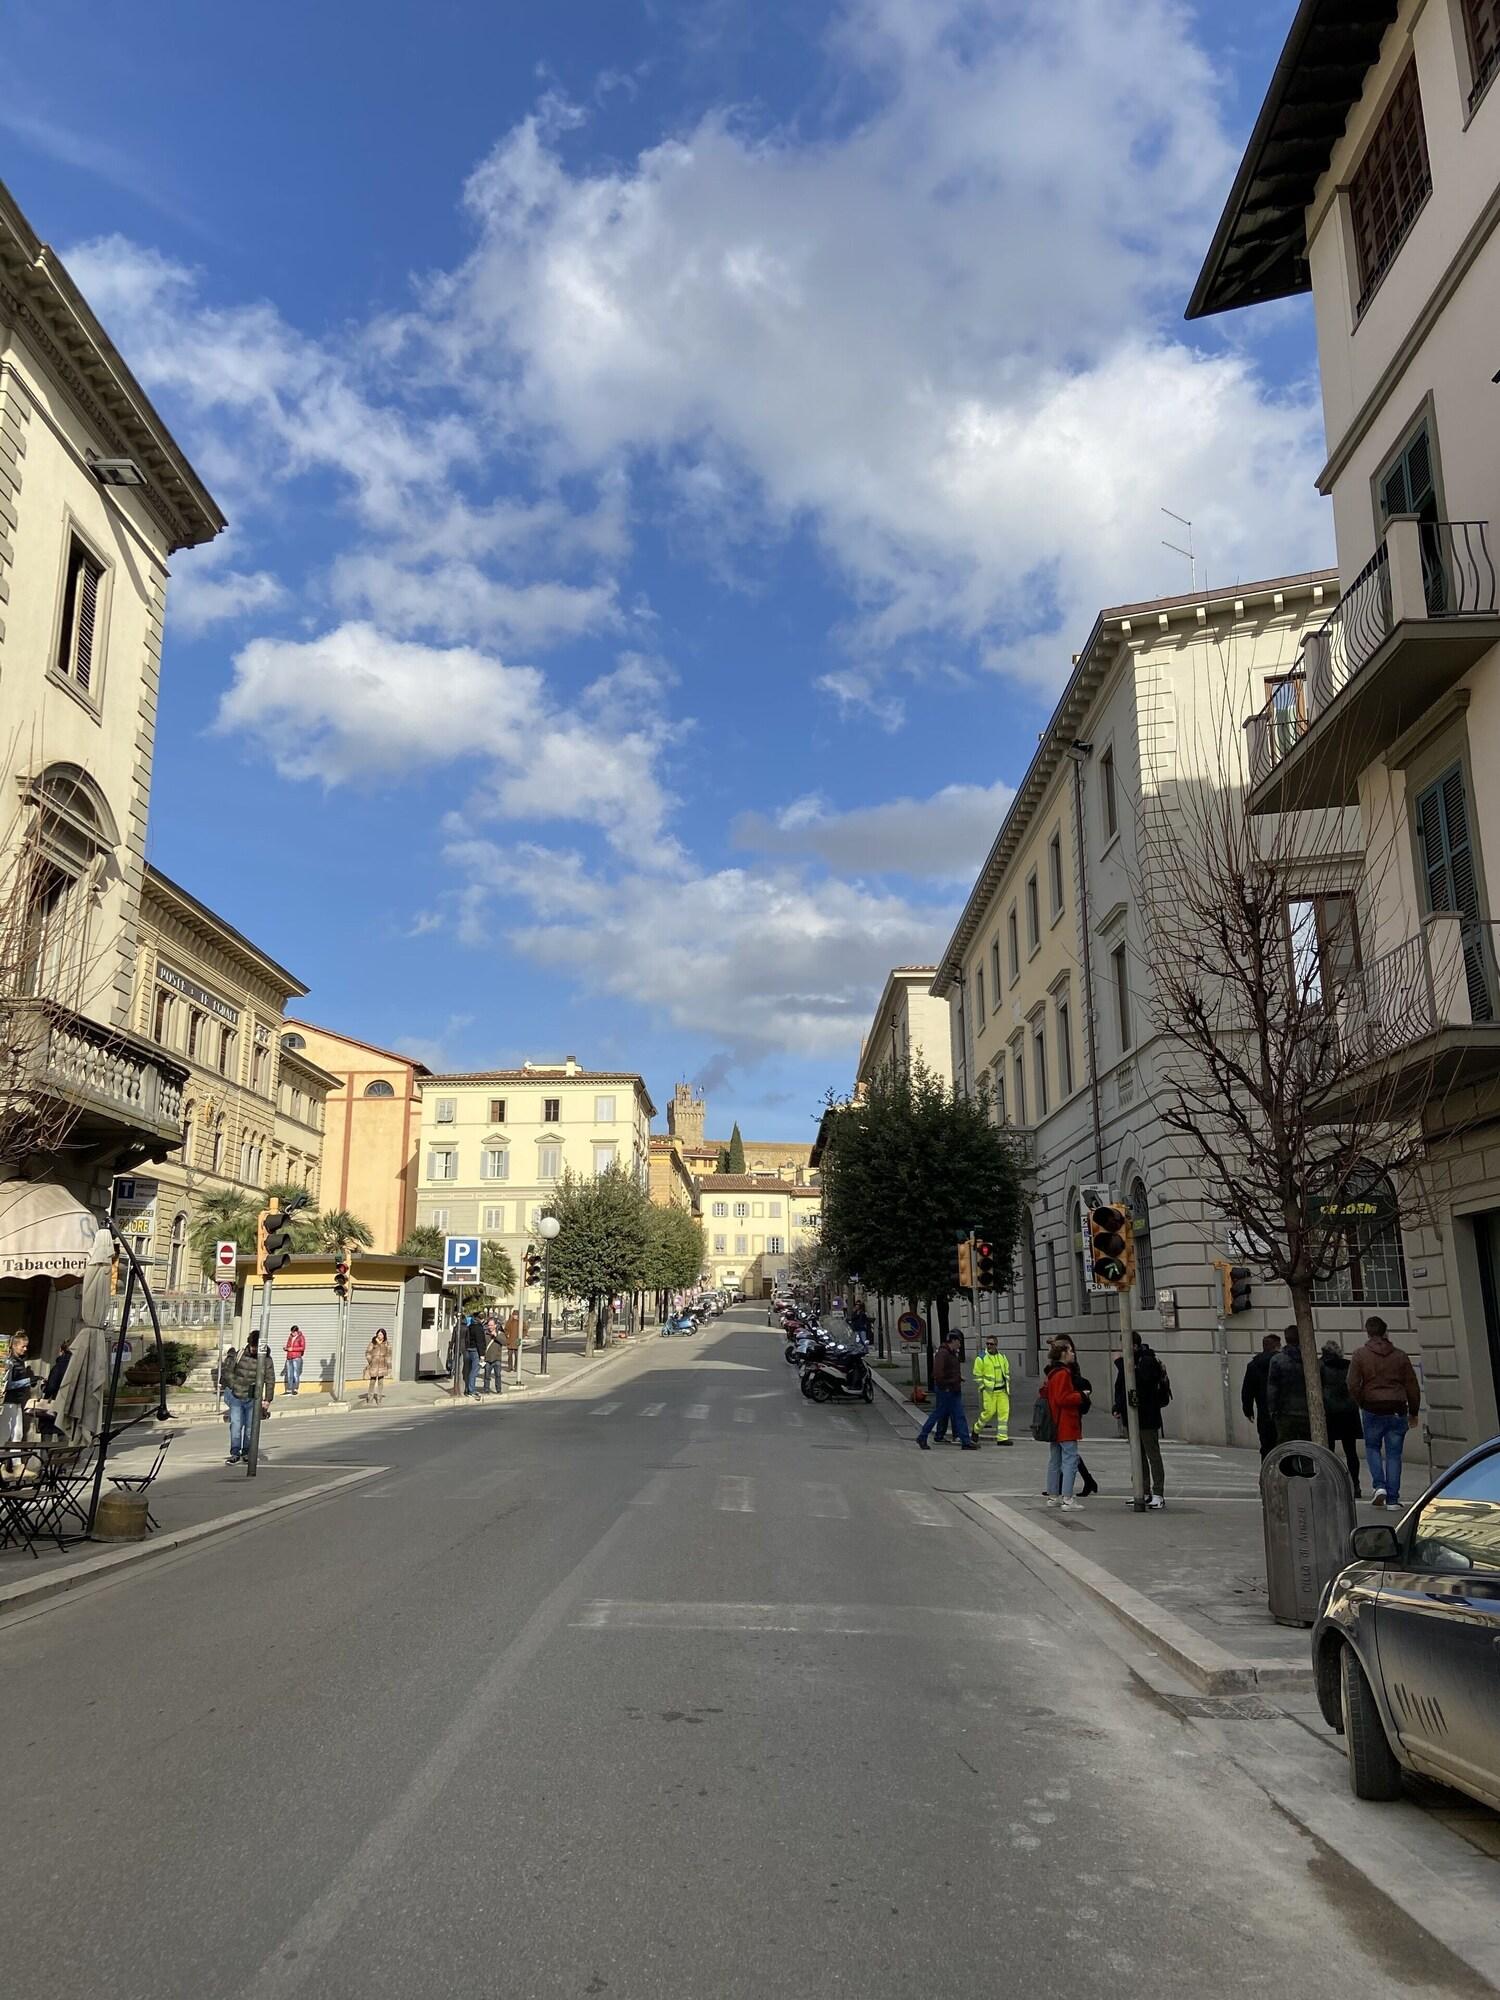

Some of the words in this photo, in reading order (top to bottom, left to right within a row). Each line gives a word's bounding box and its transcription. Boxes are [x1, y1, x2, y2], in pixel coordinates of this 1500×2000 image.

[160, 967, 186, 992] POSTE
[130, 1219, 150, 1233] ORE
[454, 1242, 471, 1264] P
[3, 1257, 87, 1272] Tabaccheri
